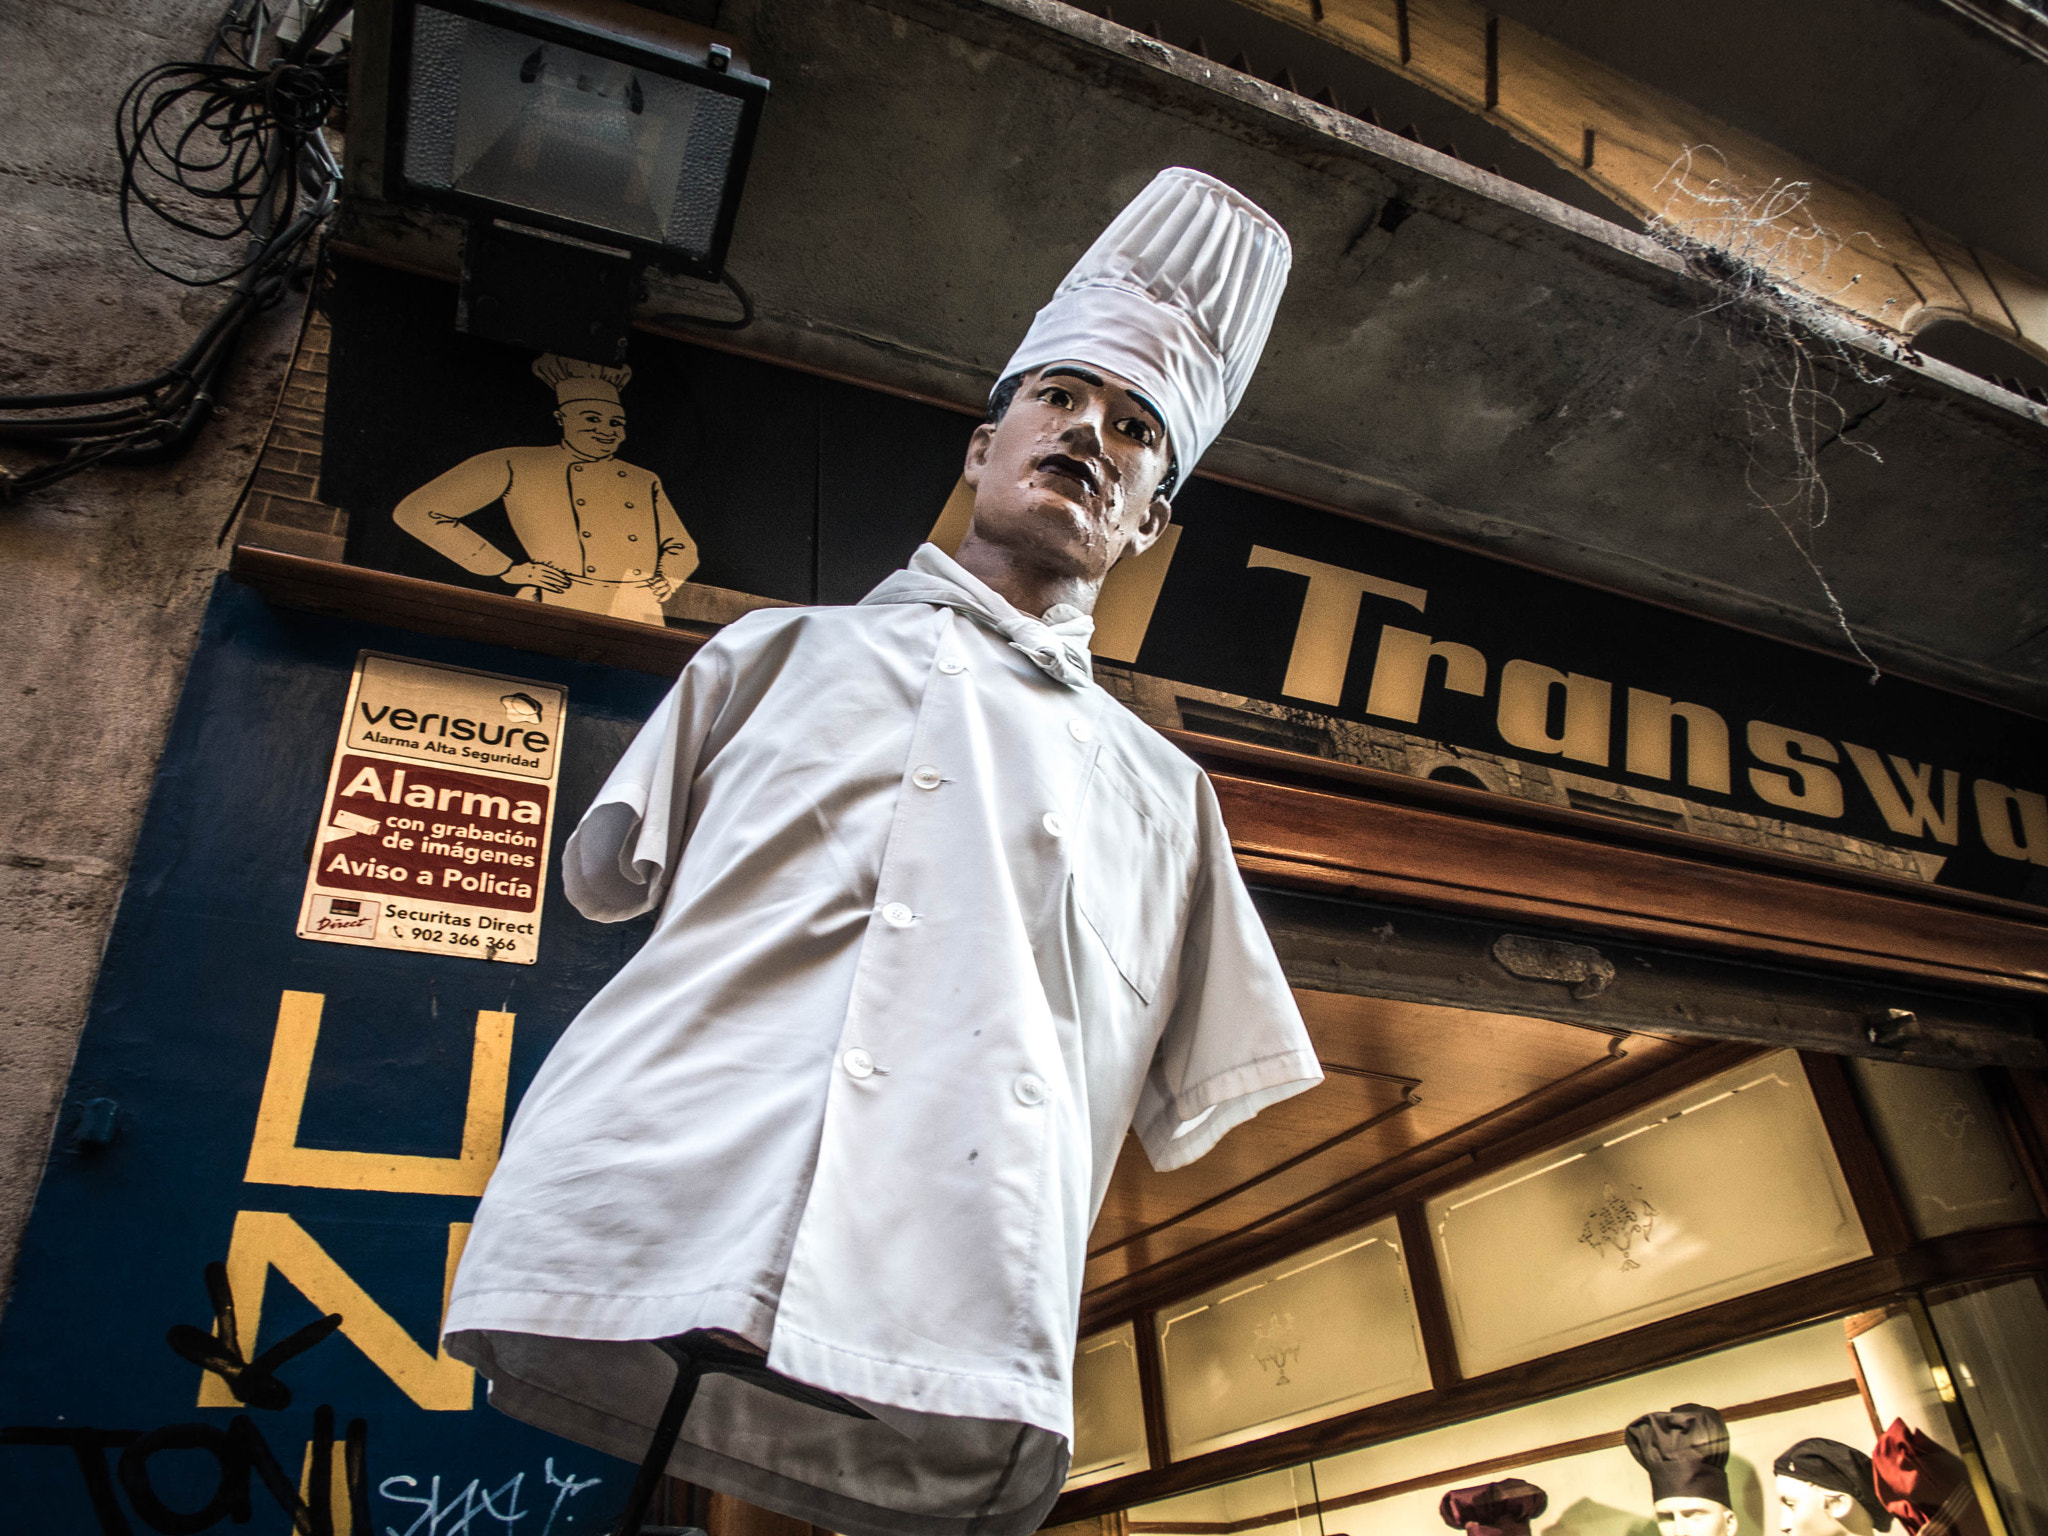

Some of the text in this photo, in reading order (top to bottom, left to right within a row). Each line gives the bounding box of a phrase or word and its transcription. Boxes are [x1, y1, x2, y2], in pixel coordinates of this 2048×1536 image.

[1246, 544, 2048, 868] Transwa
[361, 702, 550, 753] verisure
[362, 731, 540, 768] Alarma Alta Seguridad
[340, 766, 542, 825] Alarma
[382, 831, 536, 867] de imágenes
[385, 816, 538, 848] con grabación
[326, 853, 532, 898] Aviso a Policía
[316, 916, 373, 931] Direct
[385, 904, 534, 935] Securitas Direct
[411, 928, 516, 951] 902 366 366
